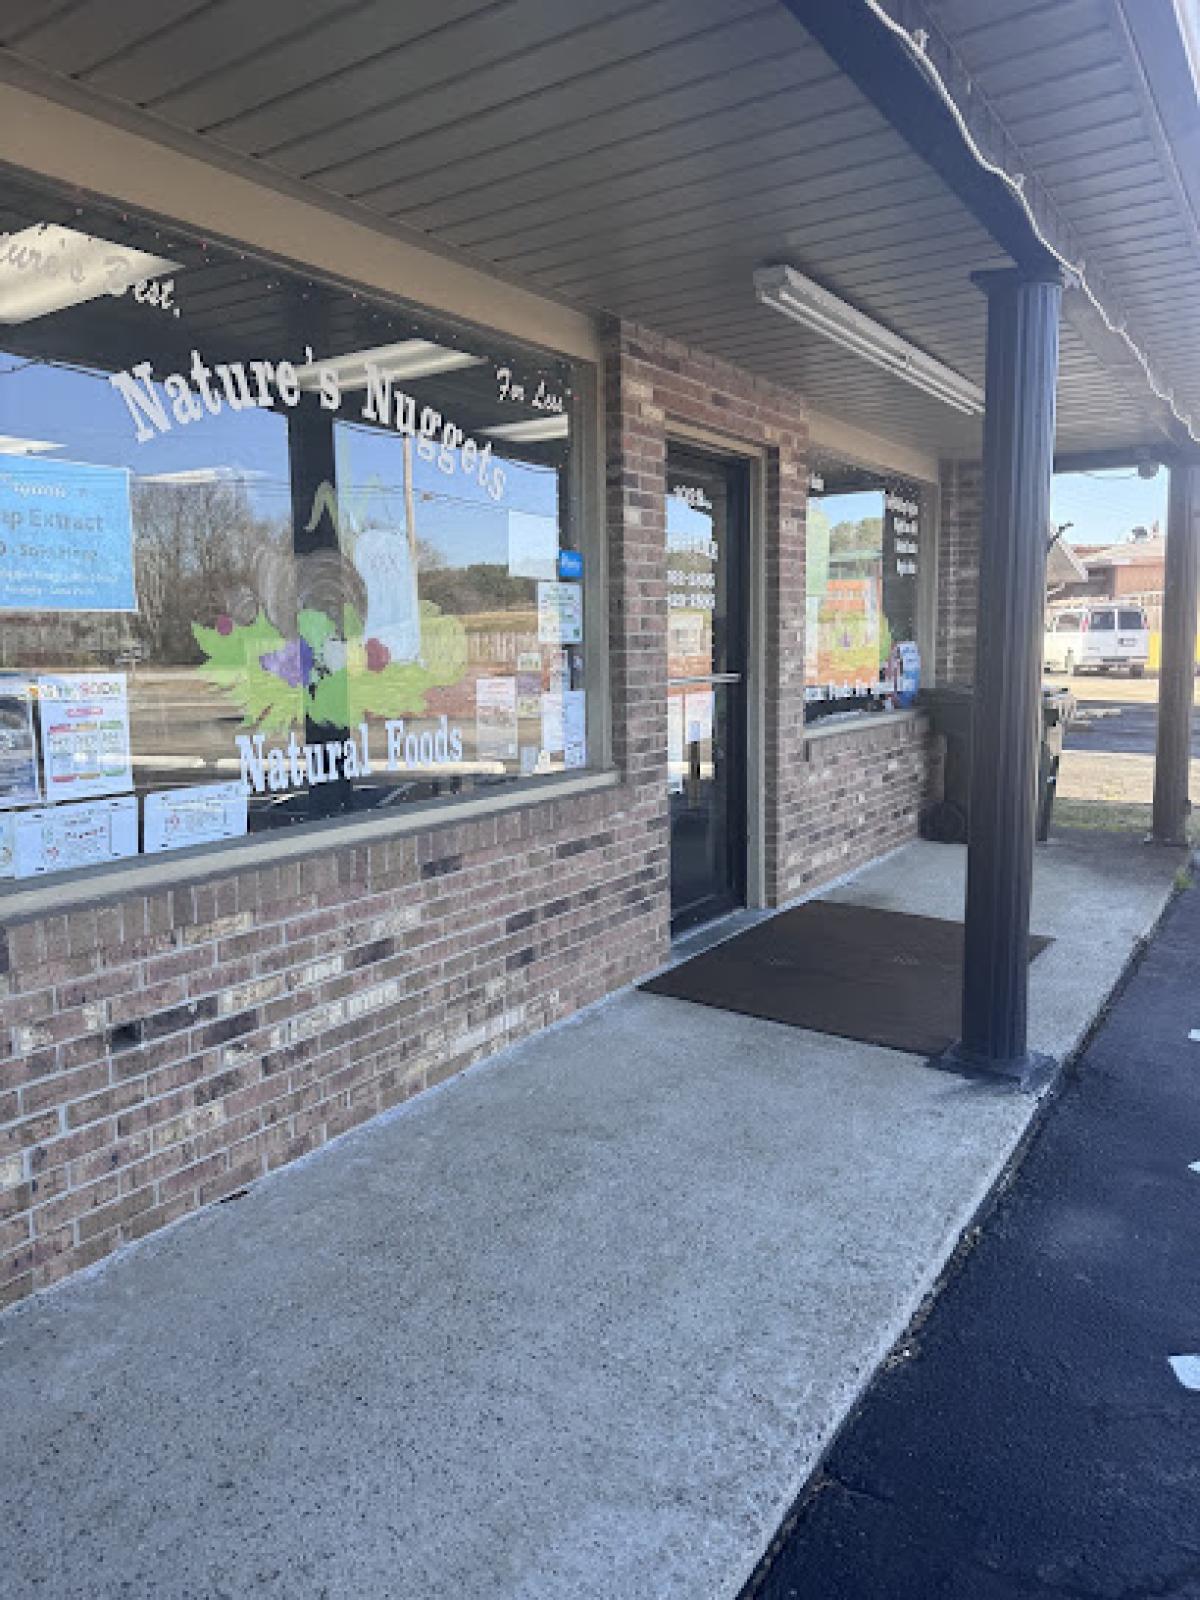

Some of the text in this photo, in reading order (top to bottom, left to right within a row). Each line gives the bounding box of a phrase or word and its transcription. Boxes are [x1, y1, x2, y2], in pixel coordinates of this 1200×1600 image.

[109, 346, 507, 502] Nature's Nuggets
[28, 508, 105, 534] Extract
[235, 714, 463, 795] Natural Foods
